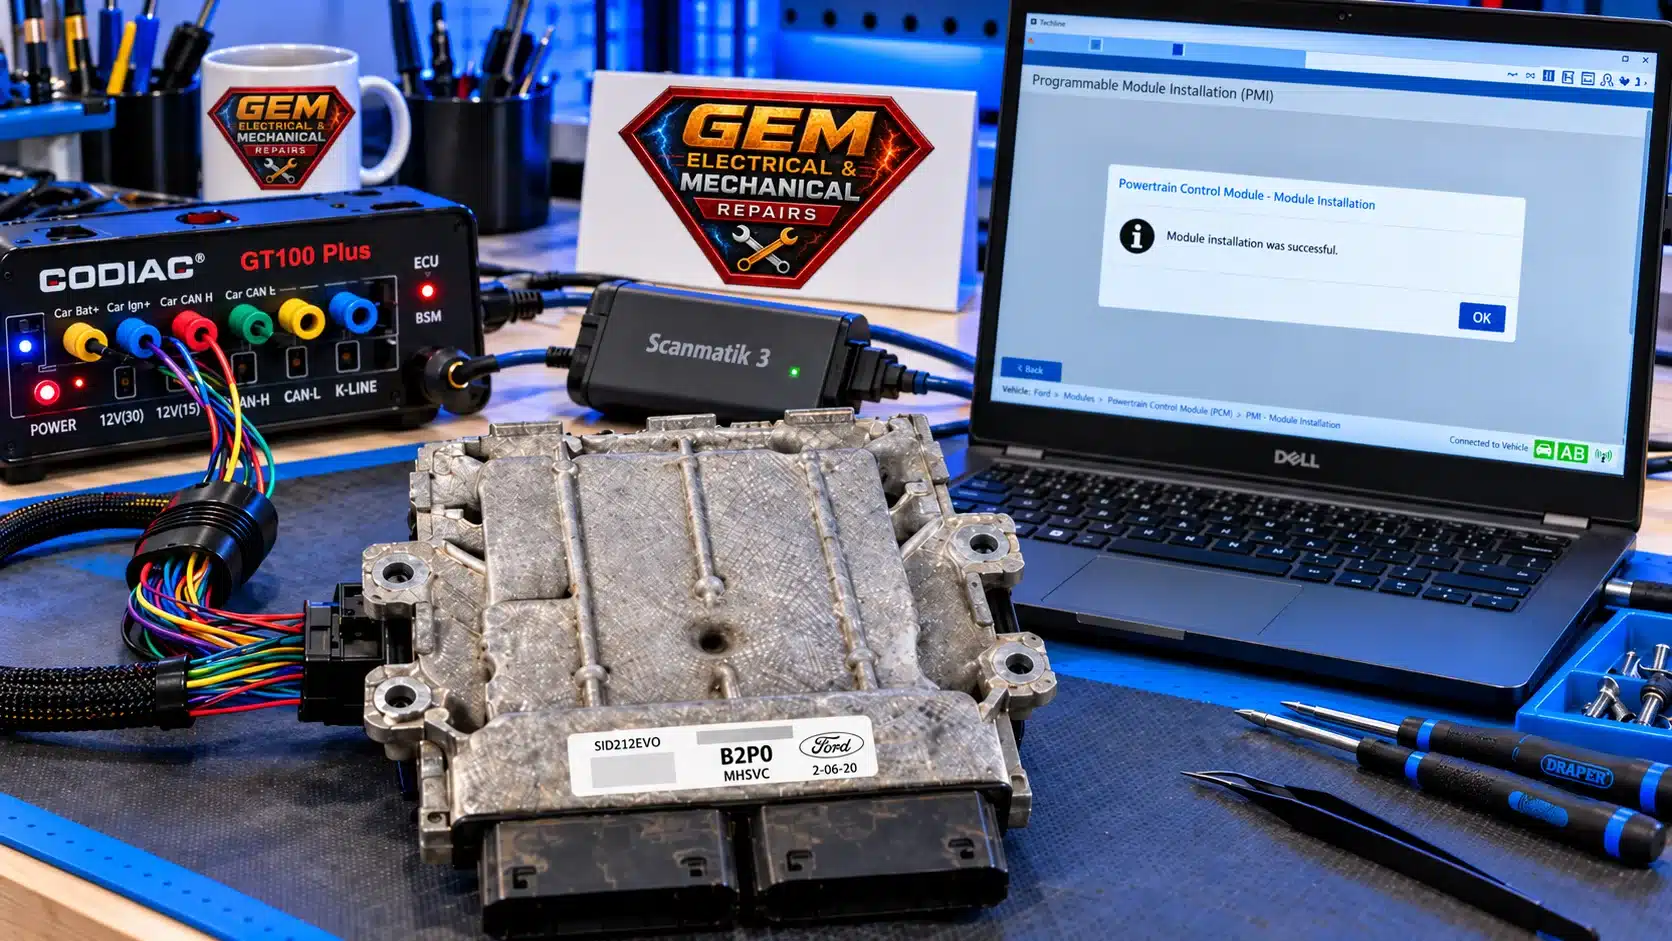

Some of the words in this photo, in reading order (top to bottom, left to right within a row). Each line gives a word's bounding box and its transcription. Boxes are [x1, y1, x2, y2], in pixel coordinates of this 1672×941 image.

[1040, 18, 1066, 28] Techline
[1032, 73, 1119, 91] Programmable
[1122, 79, 1166, 94] Module
[1169, 82, 1237, 100] Installation
[1241, 87, 1274, 104] (PMI)
[236, 94, 330, 121] GEM
[238, 121, 313, 131] ELECTRICAL
[317, 121, 325, 130] &
[682, 102, 877, 157] GEM
[237, 131, 327, 143] MECHANICAL
[255, 146, 306, 155] REPAIRS
[686, 152, 833, 176] ELECTRICAL
[841, 160, 857, 177] &
[679, 172, 861, 202] MECHANICAL
[1118, 177, 1178, 193] Powertrain
[1180, 183, 1221, 197] Control
[1223, 187, 1264, 201] Module
[1273, 191, 1315, 205] Module
[1317, 195, 1376, 211] Installation
[717, 203, 817, 221] REPAIRS
[1166, 230, 1205, 244] Module
[1208, 234, 1264, 249] installation
[1266, 241, 1286, 251] was
[1287, 243, 1338, 256] successful.
[240, 245, 315, 271] GT100
[322, 242, 372, 264] Plus
[414, 255, 439, 270] ECU
[160, 297, 178, 307] Car
[181, 294, 202, 305] CAN
[205, 292, 213, 303] H
[225, 290, 243, 300] Car
[246, 286, 267, 298] CAN
[54, 307, 73, 319] Car
[76, 306, 99, 317] Bat+
[107, 302, 125, 313] Car
[128, 300, 151, 313] Ign+
[415, 309, 442, 324] BSM
[1472, 310, 1492, 325] OK
[646, 332, 753, 366] Scanmatik
[755, 348, 771, 368] 3
[1025, 364, 1044, 376] Back
[284, 387, 321, 404] CAN-L
[335, 380, 377, 397] K-LINE
[236, 392, 270, 409] AN-H
[1002, 385, 1031, 396] Vehicle:
[1033, 388, 1051, 398] Ford
[1063, 391, 1095, 403] Modules
[1107, 396, 1148, 409] Powertrain
[1150, 400, 1178, 412] Control
[1179, 404, 1208, 416] Module
[1210, 407, 1233, 419] (PCM)
[1245, 411, 1262, 421] PMI
[1269, 413, 1298, 425] Module
[1299, 417, 1341, 430] Installation
[100, 408, 144, 427] 12V(30)
[156, 402, 200, 419] 12V(15)
[30, 418, 77, 437] POWER
[1449, 435, 1490, 449] Connected
[1491, 440, 1500, 449] to
[1501, 440, 1529, 452] Vehicle
[1274, 449, 1320, 469] DELL
[1560, 445, 1585, 461] AB
[594, 736, 661, 752] SID212EVO
[811, 735, 852, 754] Ford
[723, 767, 770, 783] MHSVC
[812, 762, 857, 776] 2-06-20
[1545, 757, 1608, 785] DRAPER
